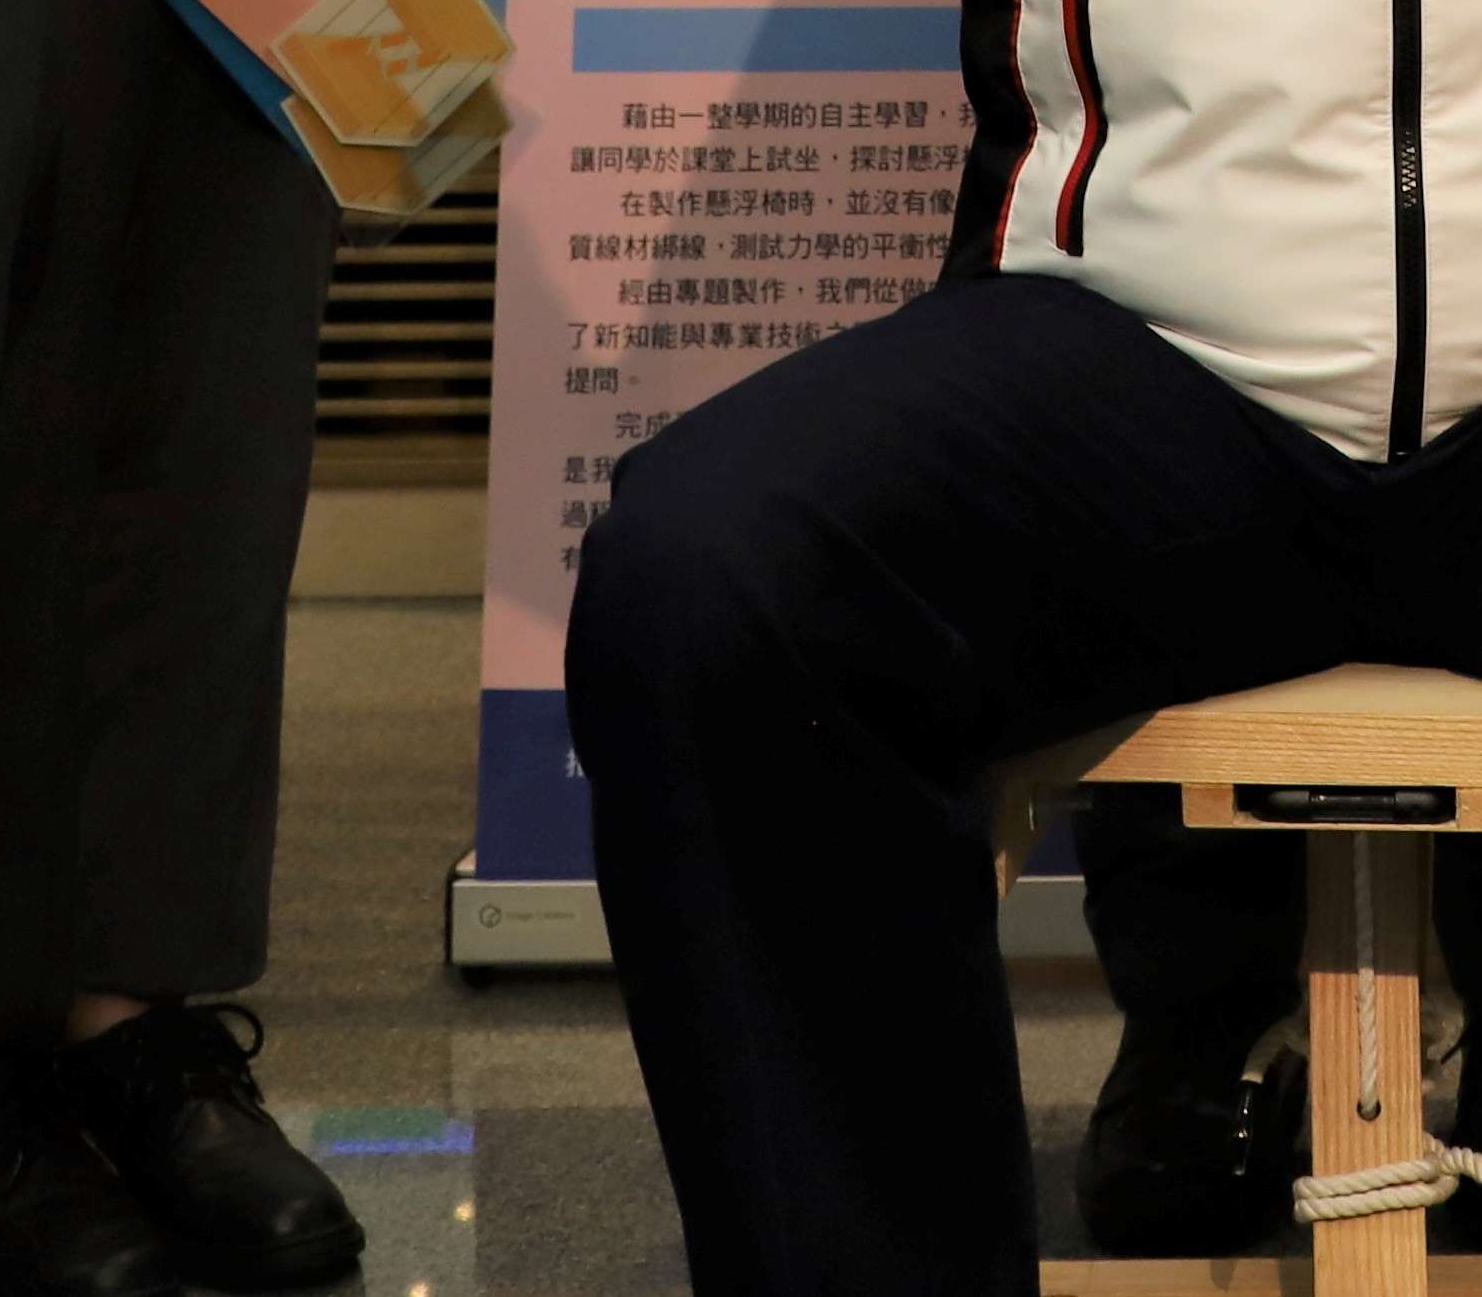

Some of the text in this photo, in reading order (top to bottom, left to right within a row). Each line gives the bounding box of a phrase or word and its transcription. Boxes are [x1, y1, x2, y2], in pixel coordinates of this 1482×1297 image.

[570, 143, 970, 174] 讓同學於課堂上試坐，探討懸浮
